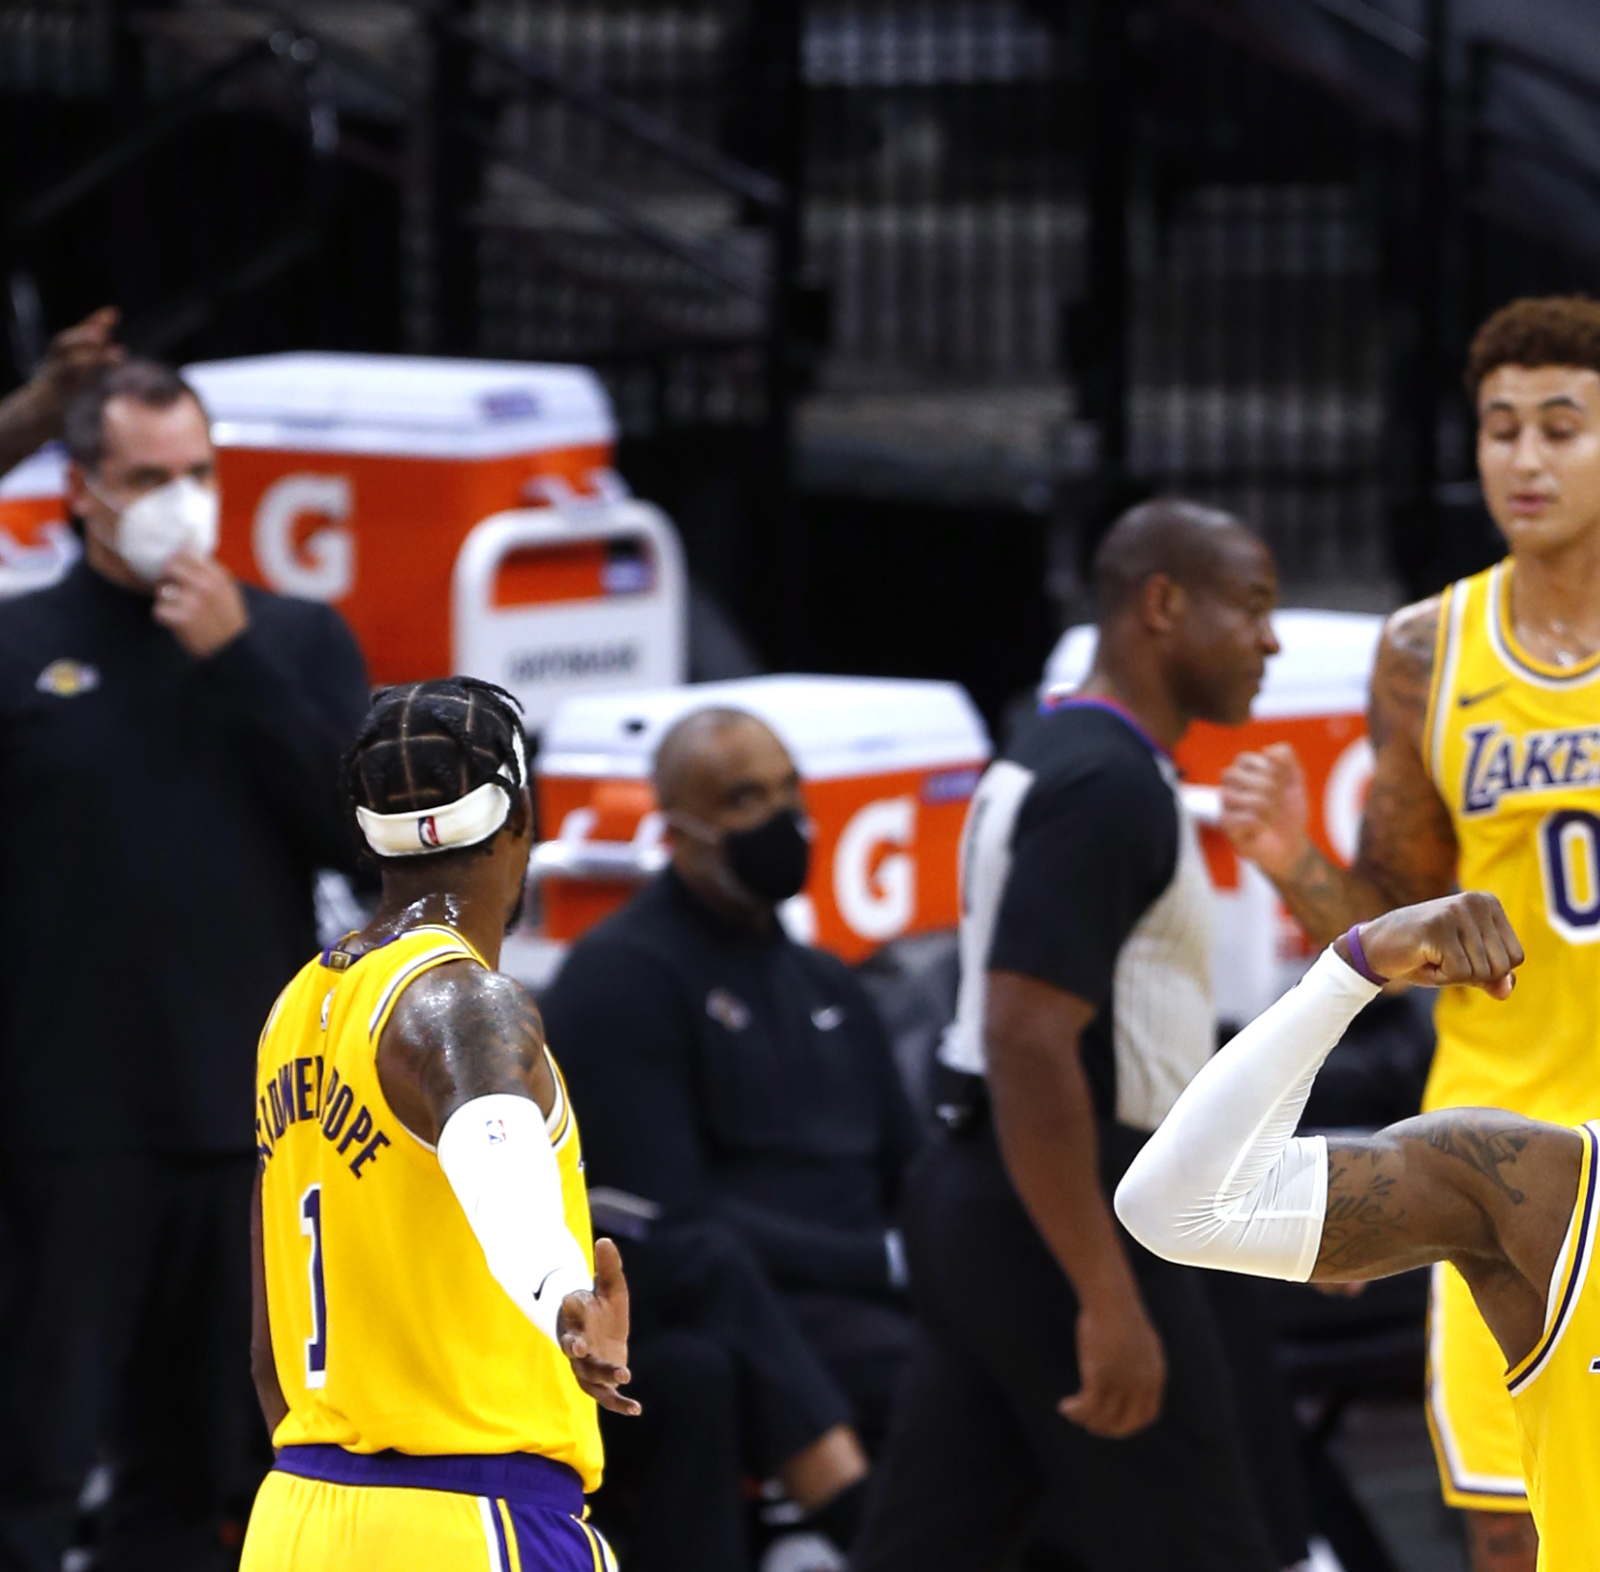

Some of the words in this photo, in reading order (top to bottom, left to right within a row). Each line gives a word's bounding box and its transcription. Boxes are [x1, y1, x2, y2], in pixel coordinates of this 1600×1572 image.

[252, 473, 355, 600] G
[833, 796, 917, 940] G
[300, 1181, 327, 1390] 1
